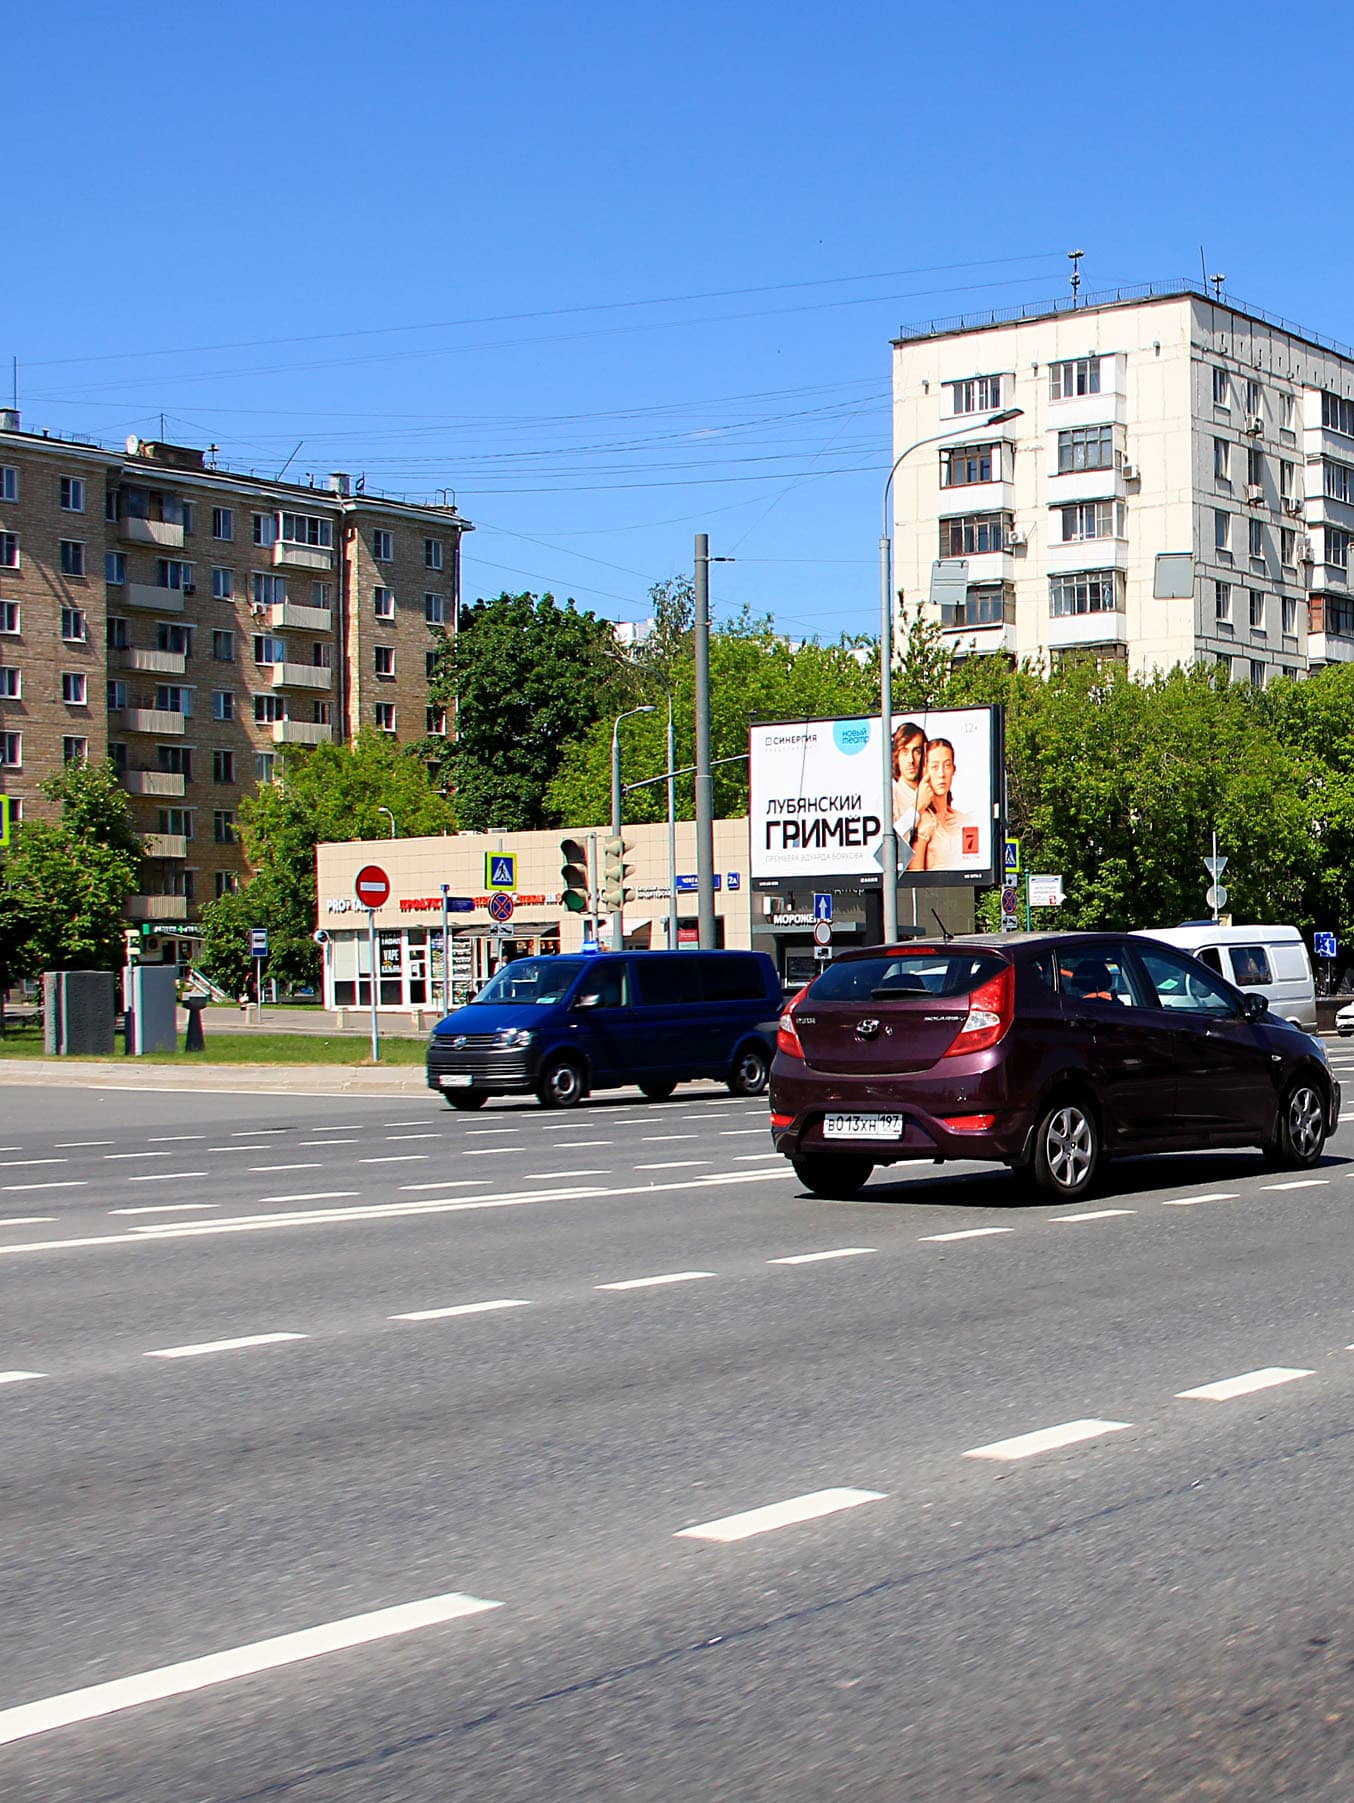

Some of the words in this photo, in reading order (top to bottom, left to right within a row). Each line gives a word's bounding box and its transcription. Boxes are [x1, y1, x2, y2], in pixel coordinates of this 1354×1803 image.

[773, 734, 817, 745] СИНЕРГИЯ
[766, 793, 862, 815] ЛУБЯНСКИЙ
[765, 814, 881, 850] ГРИМЁР
[965, 834, 974, 850] 7
